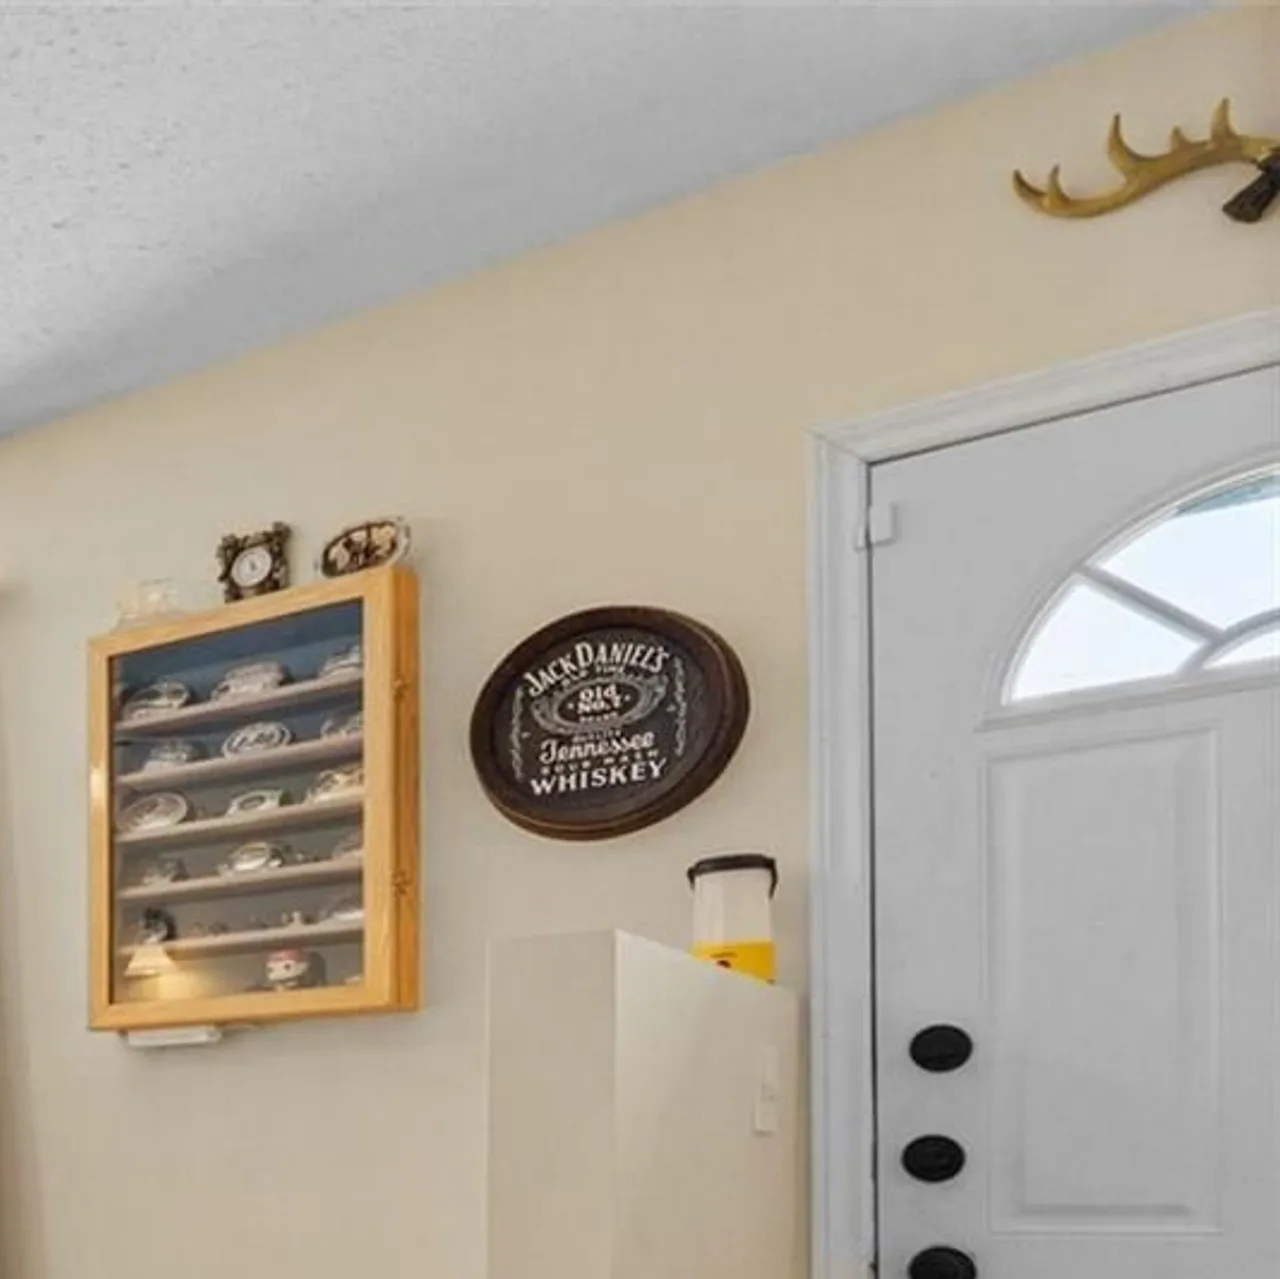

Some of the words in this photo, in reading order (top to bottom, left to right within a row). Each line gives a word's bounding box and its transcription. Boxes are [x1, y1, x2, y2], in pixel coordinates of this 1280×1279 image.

[523, 653, 581, 697] JACK
[540, 731, 655, 764] Tennessee
[530, 757, 667, 796] WHISKEY
